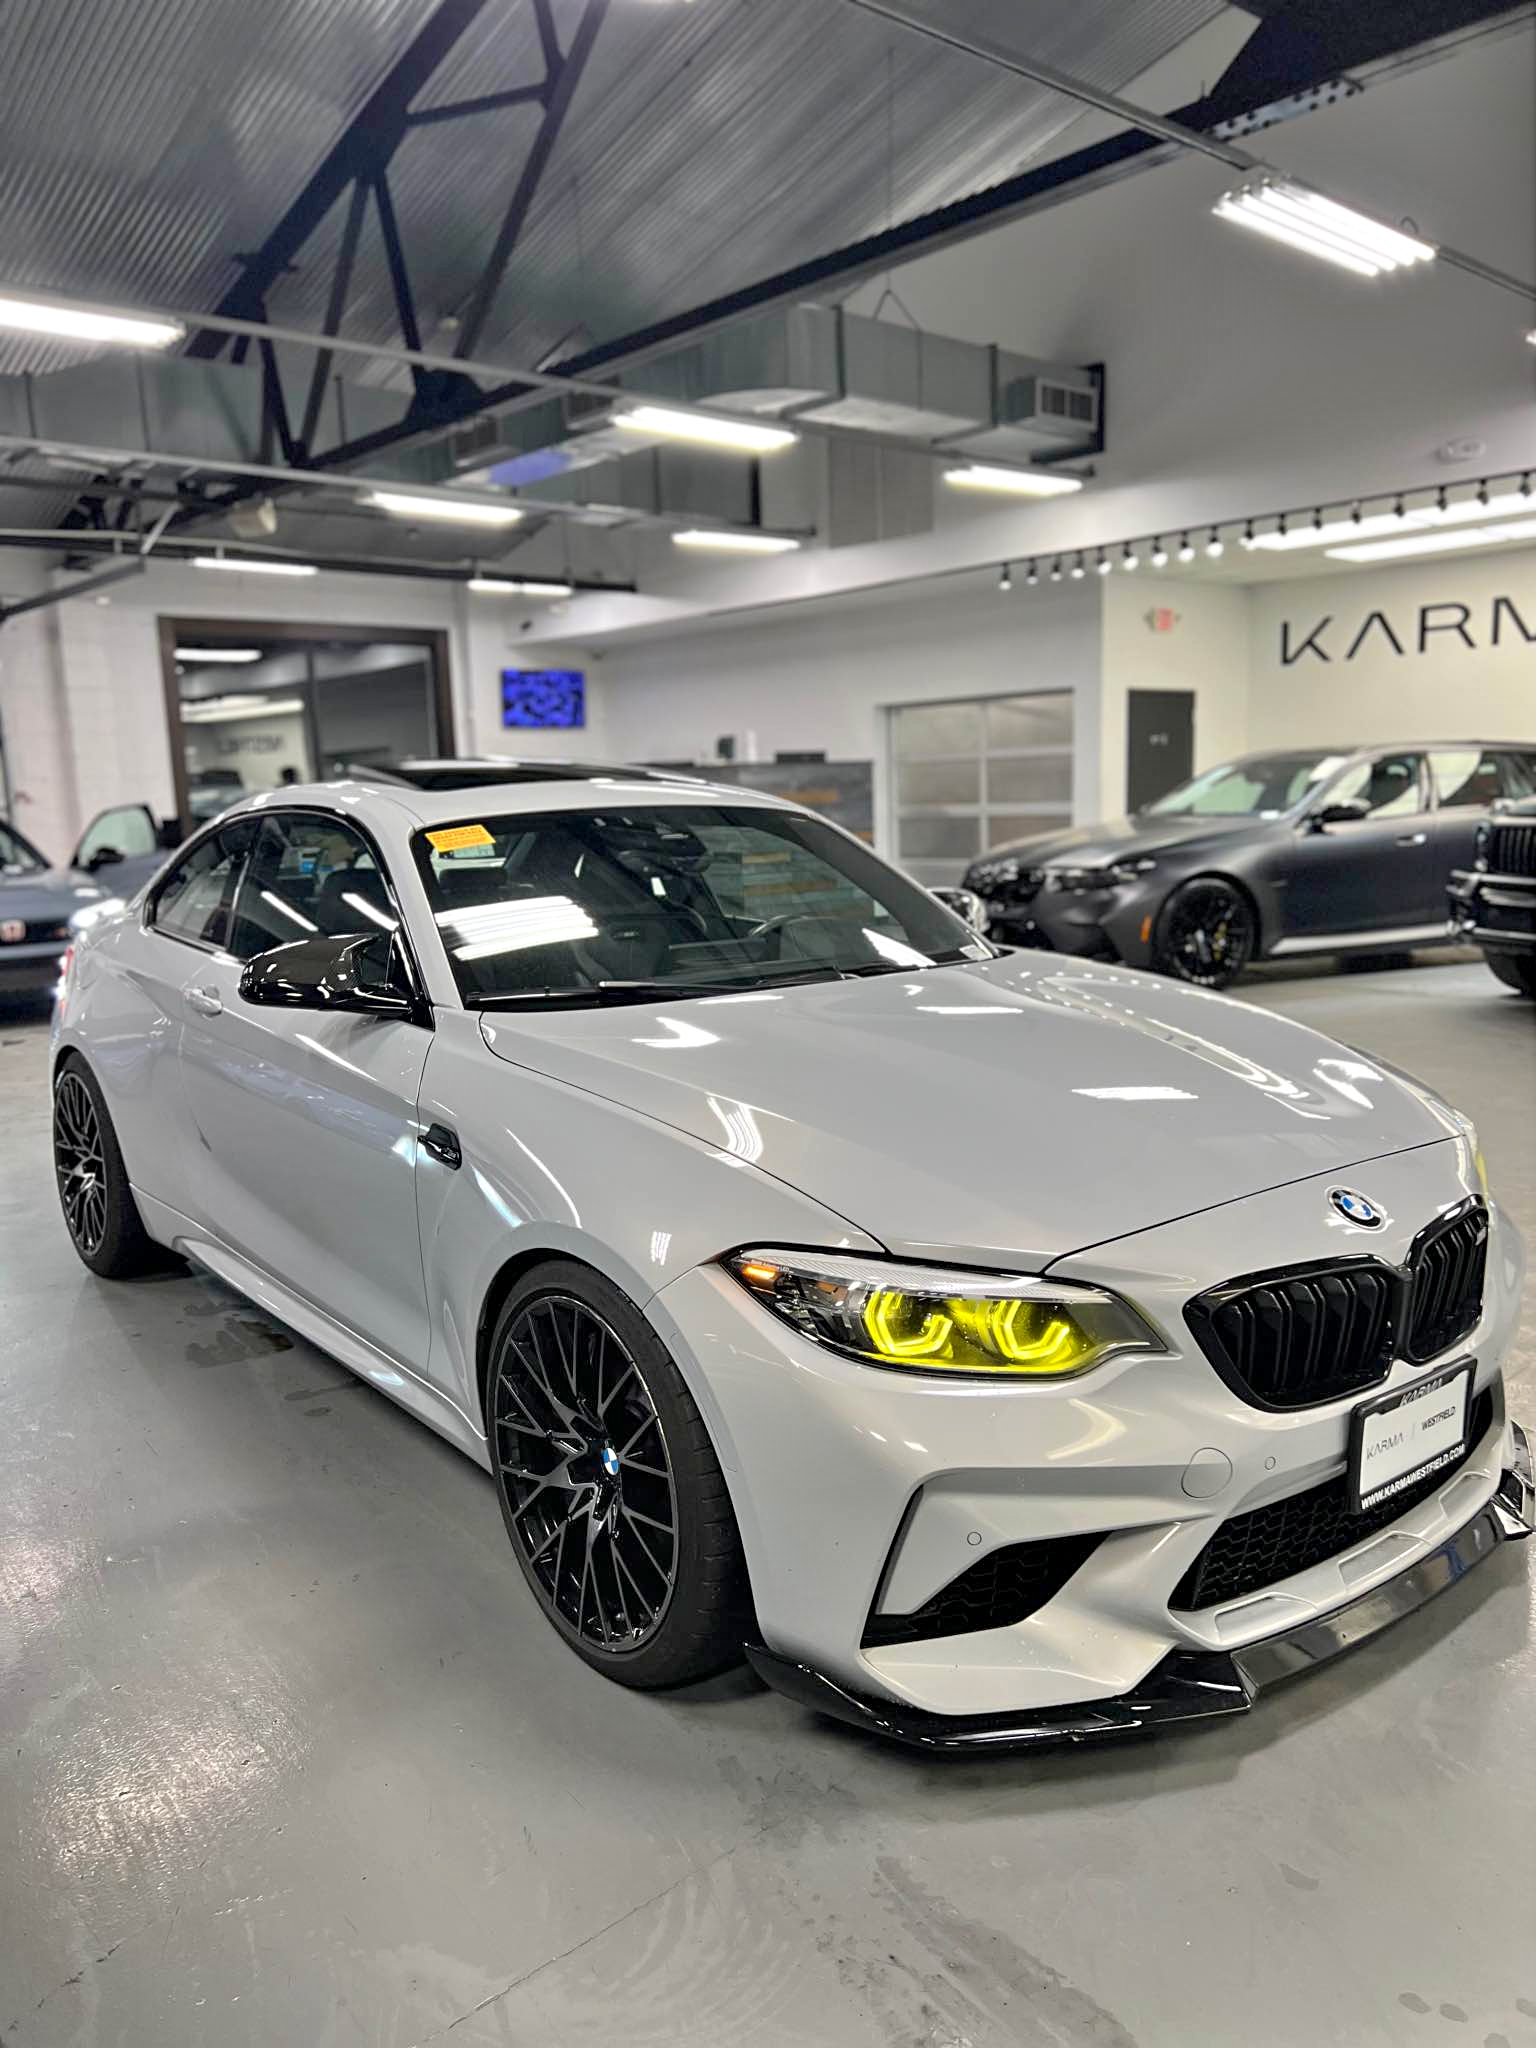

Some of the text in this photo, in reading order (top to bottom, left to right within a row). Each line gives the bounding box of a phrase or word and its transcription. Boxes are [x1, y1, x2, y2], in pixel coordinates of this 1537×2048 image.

[1366, 1406, 1456, 1461] KARMA WESTFIELD
[1361, 1443, 1466, 1510] WWW.KARMAWESTFIELD.COM
